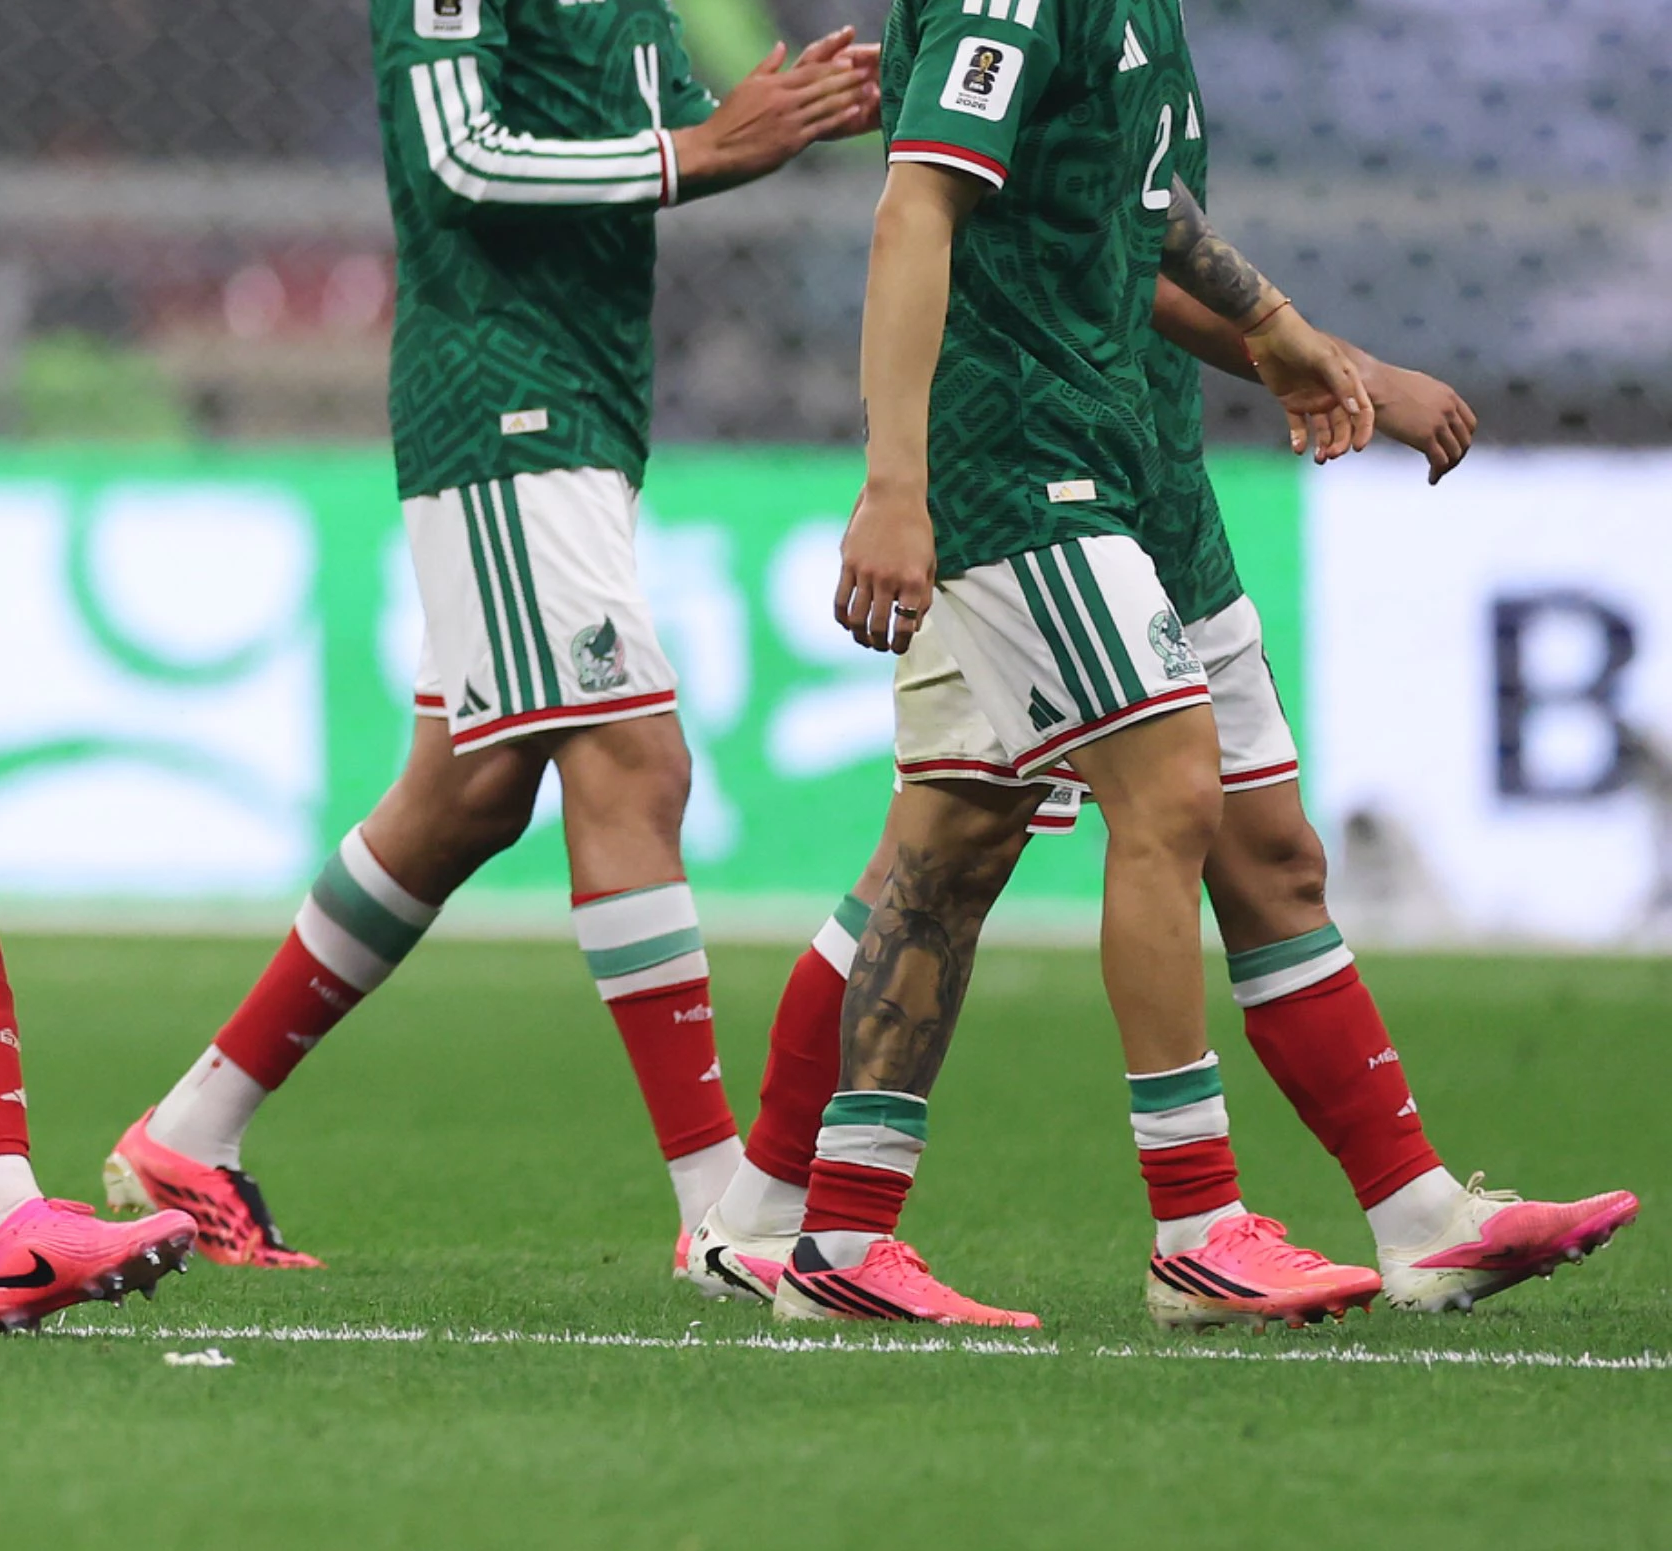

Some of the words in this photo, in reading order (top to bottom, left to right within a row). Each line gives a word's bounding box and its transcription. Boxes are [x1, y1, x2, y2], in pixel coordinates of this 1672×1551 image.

[955, 97, 987, 110] 2026
[1142, 104, 1172, 210] 2
[1492, 591, 1634, 800] B
